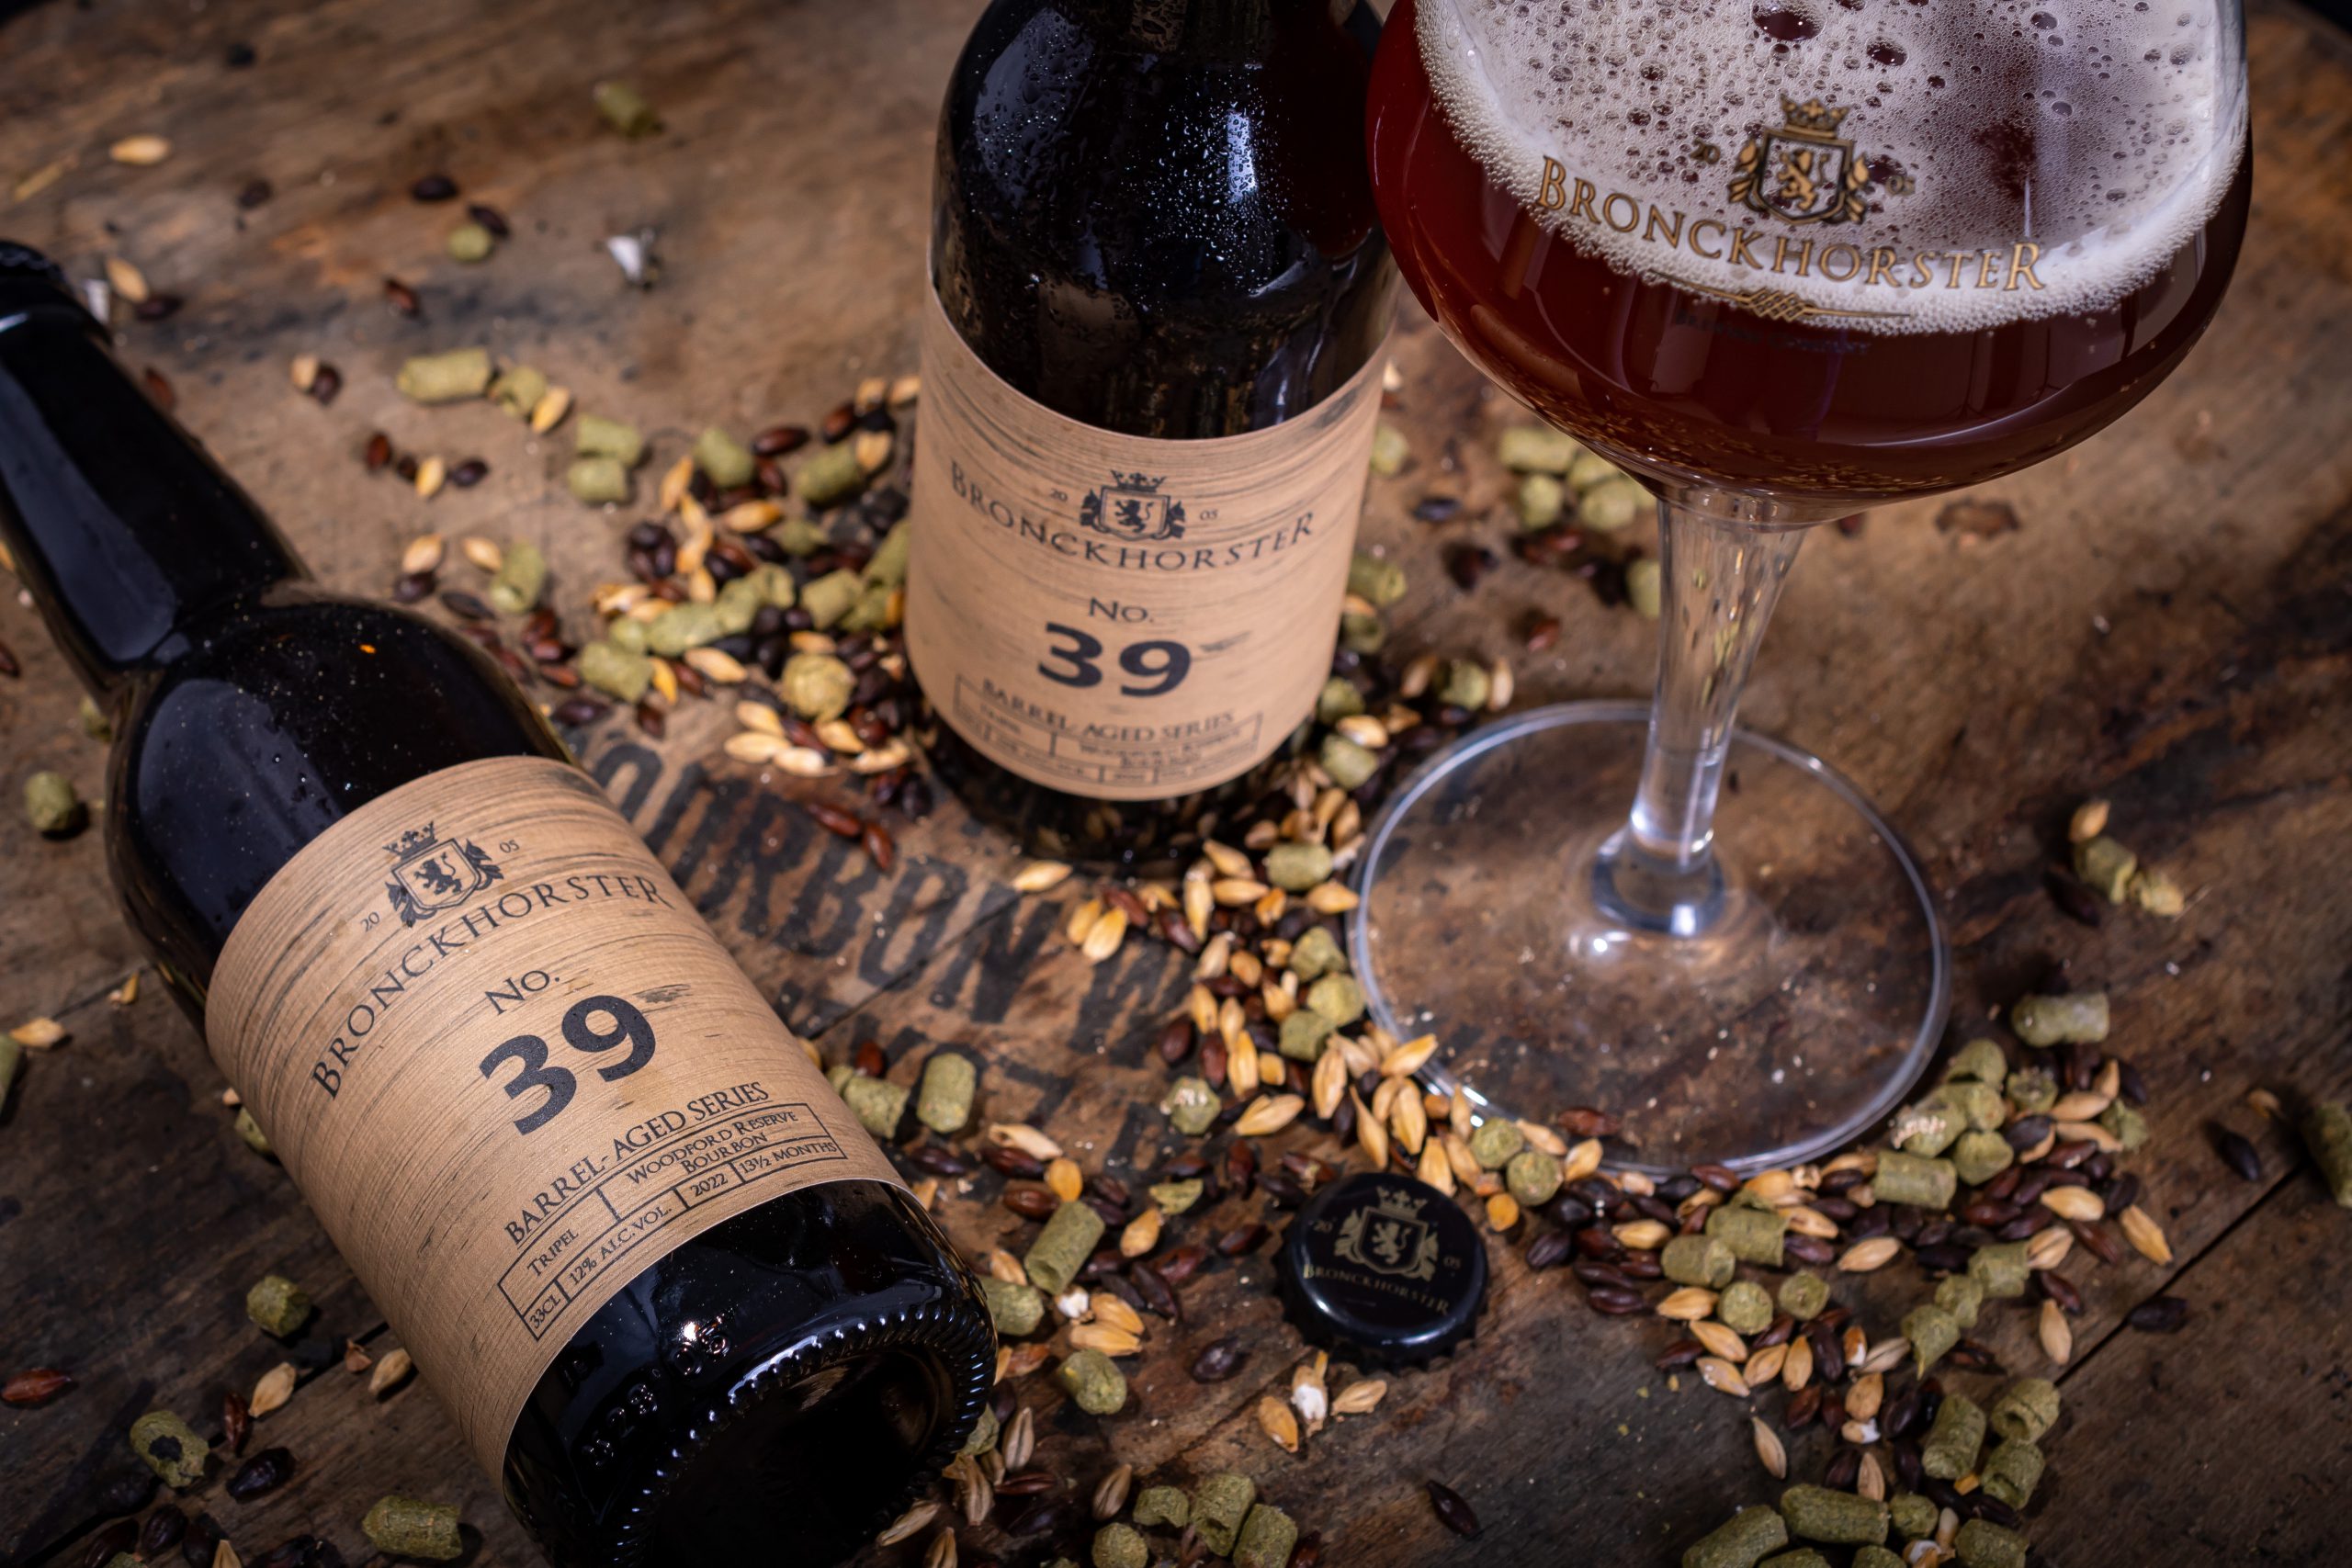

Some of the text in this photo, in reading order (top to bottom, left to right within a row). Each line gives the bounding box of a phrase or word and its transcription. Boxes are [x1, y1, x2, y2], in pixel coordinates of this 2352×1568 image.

[1538, 154, 2045, 291] BRONCKHORSTER
[950, 461, 1315, 571] BRONCKHORSTER
[1037, 622, 1193, 698] 39
[361, 839, 520, 933] 20 05
[312, 873, 676, 1100] BRONCKHORSTER
[479, 995, 657, 1136] 39
[686, 1081, 769, 1122] SERIES
[626, 1111, 798, 1185] WOODFORD RESERVE
[681, 1132, 768, 1176] BOURBON
[526, 1228, 580, 1277] TRIPEL
[569, 1257, 597, 1286] 12%
[690, 1172, 729, 1198] 2022
[775, 1141, 838, 1162] MONTHS
